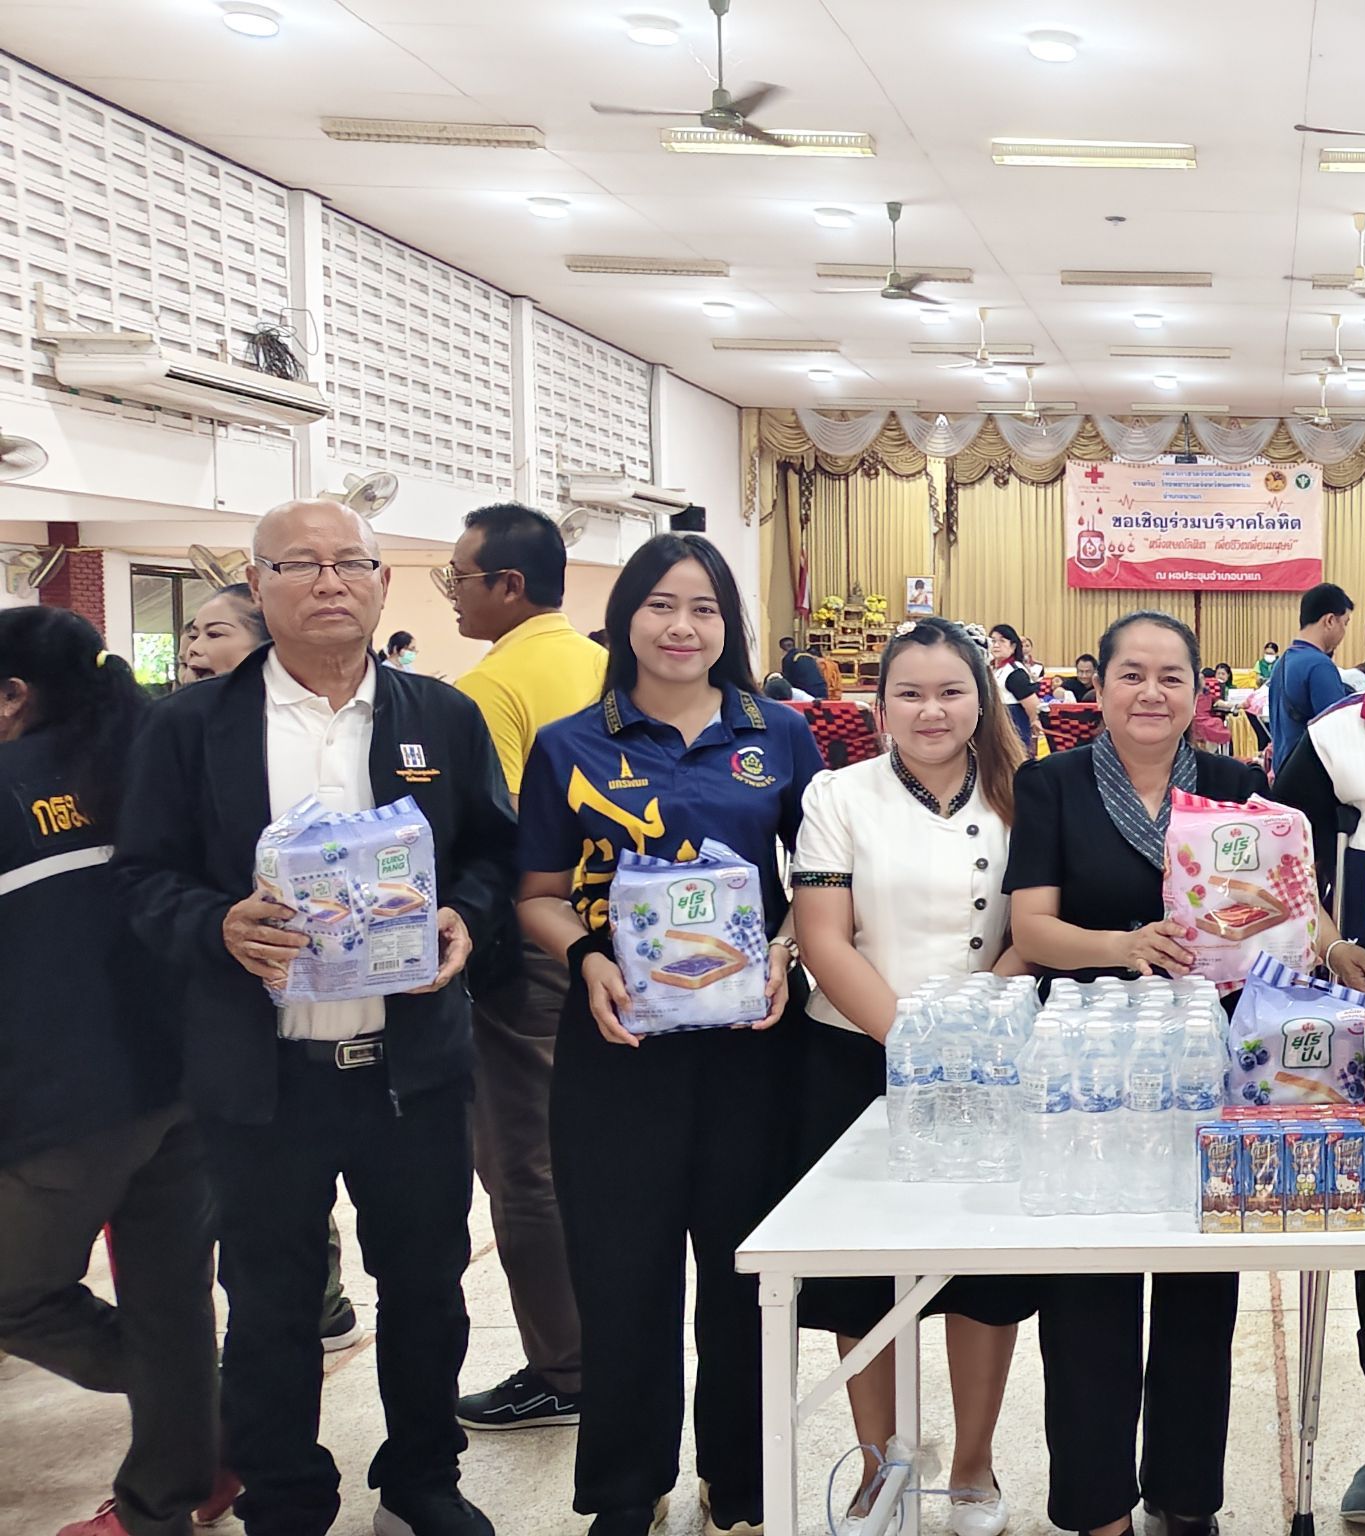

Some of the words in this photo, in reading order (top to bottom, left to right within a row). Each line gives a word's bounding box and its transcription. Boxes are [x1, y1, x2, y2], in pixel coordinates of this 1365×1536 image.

[1112, 511, 1302, 533] ขอเชิญร่วมบริจาคโลหิต
[1156, 573, 1167, 581] ณ
[381, 853, 405, 866] EURO
[382, 861, 405, 874] PANG
